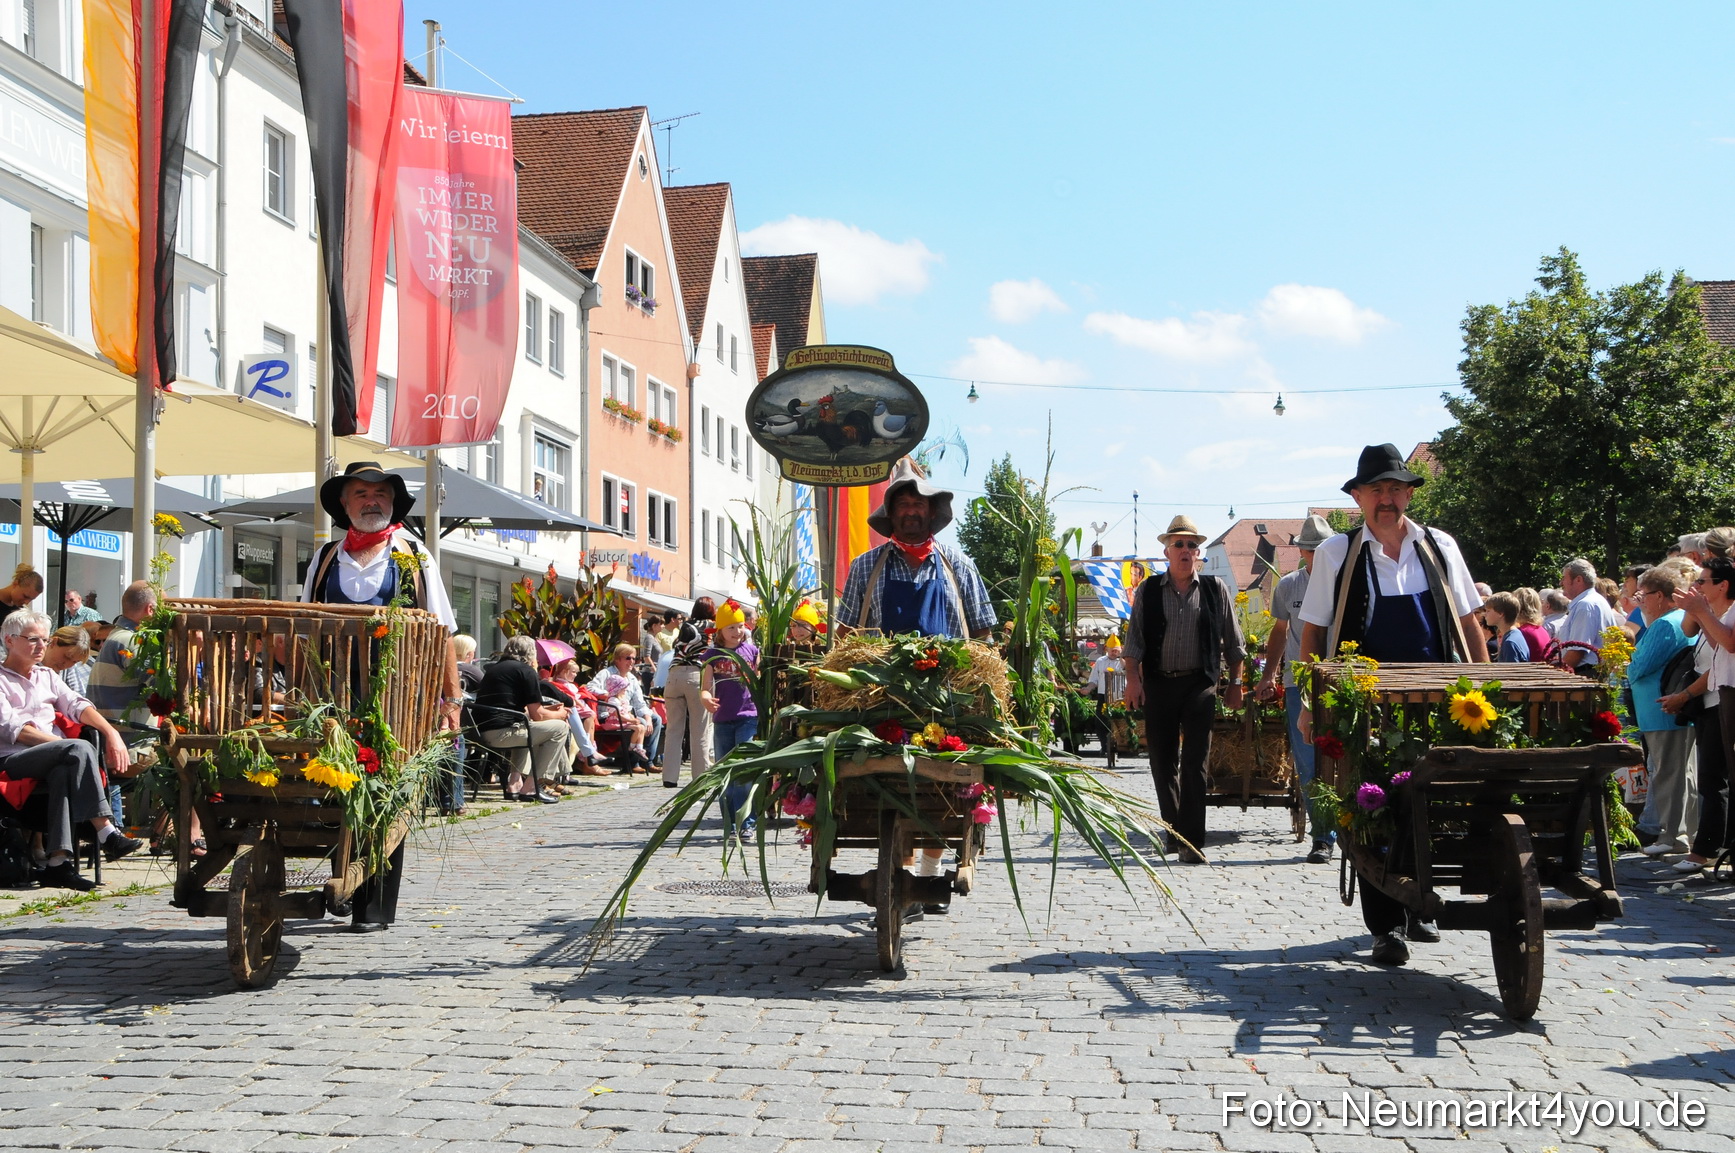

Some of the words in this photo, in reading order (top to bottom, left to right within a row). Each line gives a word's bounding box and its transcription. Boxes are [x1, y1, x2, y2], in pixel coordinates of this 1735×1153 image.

[418, 187, 495, 211] IMMER
[424, 231, 492, 264] NEU
[87, 531, 118, 551] WEBER
[246, 544, 274, 561] Rupprecht
